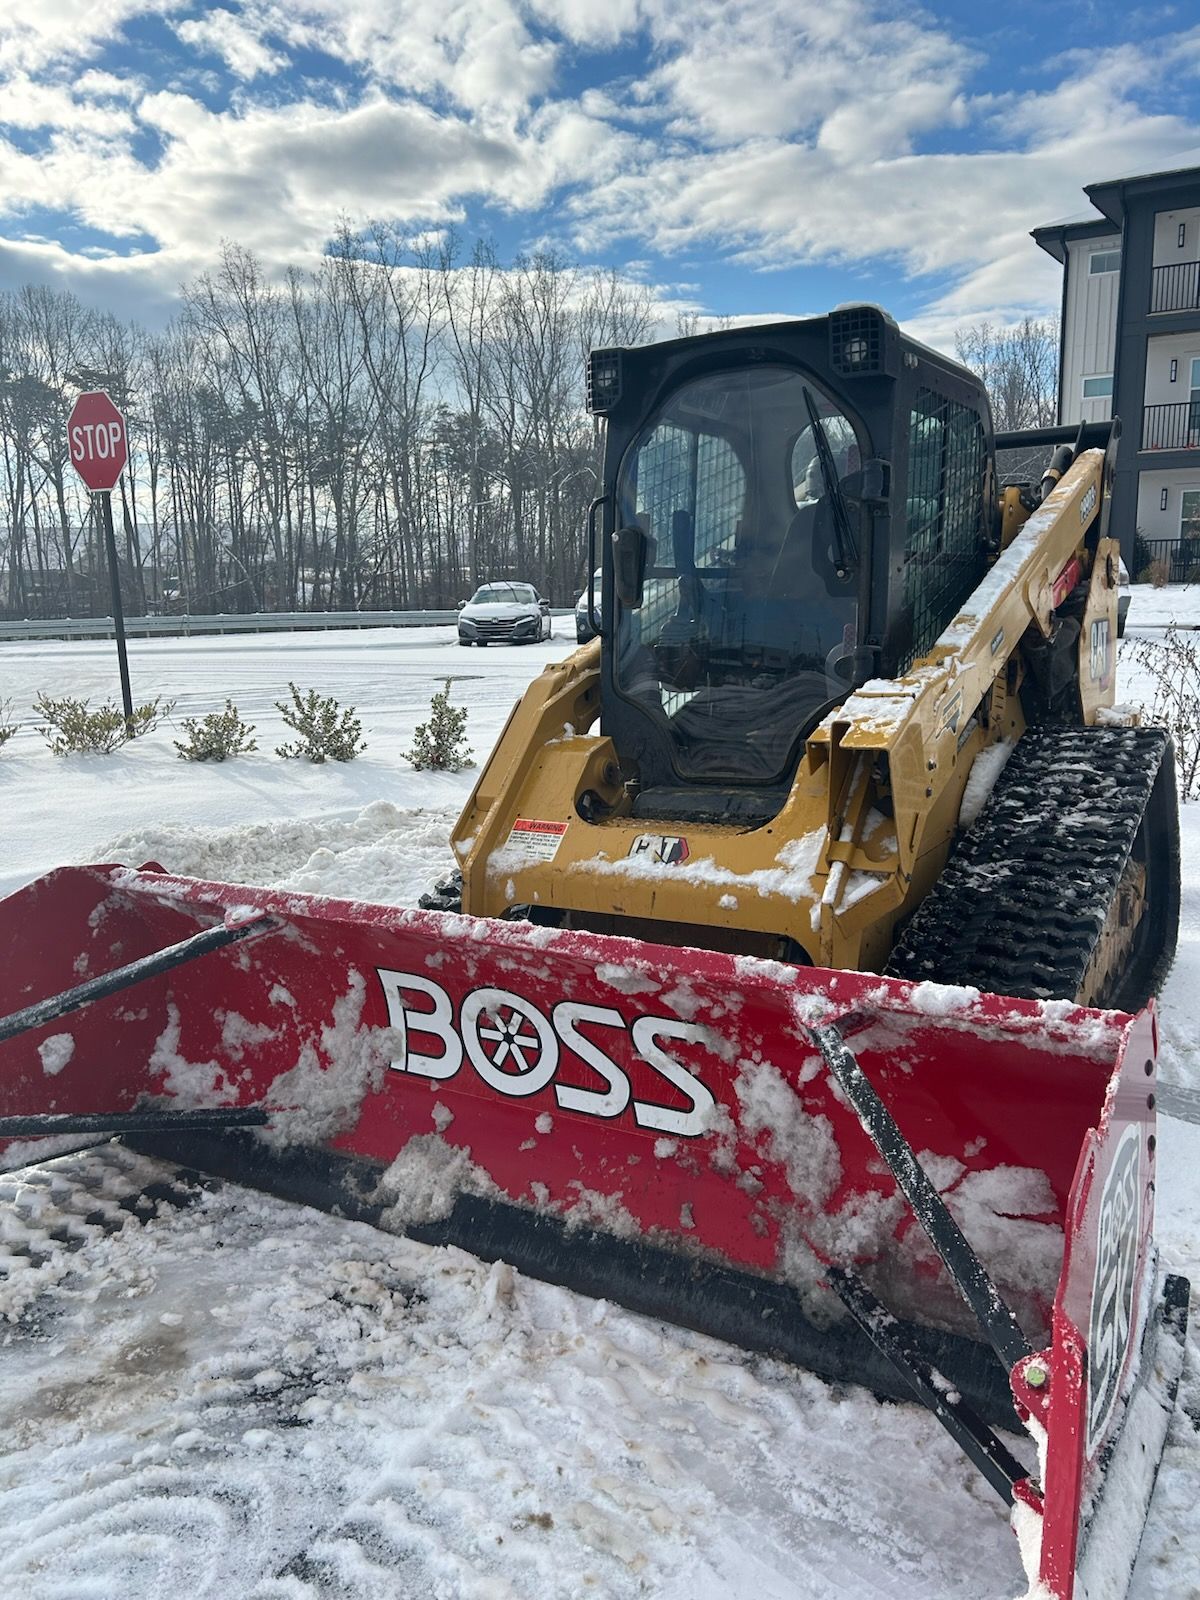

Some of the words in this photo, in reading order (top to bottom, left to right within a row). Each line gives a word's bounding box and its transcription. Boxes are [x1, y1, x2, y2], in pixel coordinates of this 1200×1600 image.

[72, 422, 122, 461] STOP
[528, 822, 563, 832] WARNING
[376, 967, 716, 1138] BOSS
[1099, 1146, 1138, 1286] BOSS
[1091, 1226, 1133, 1431] SK
